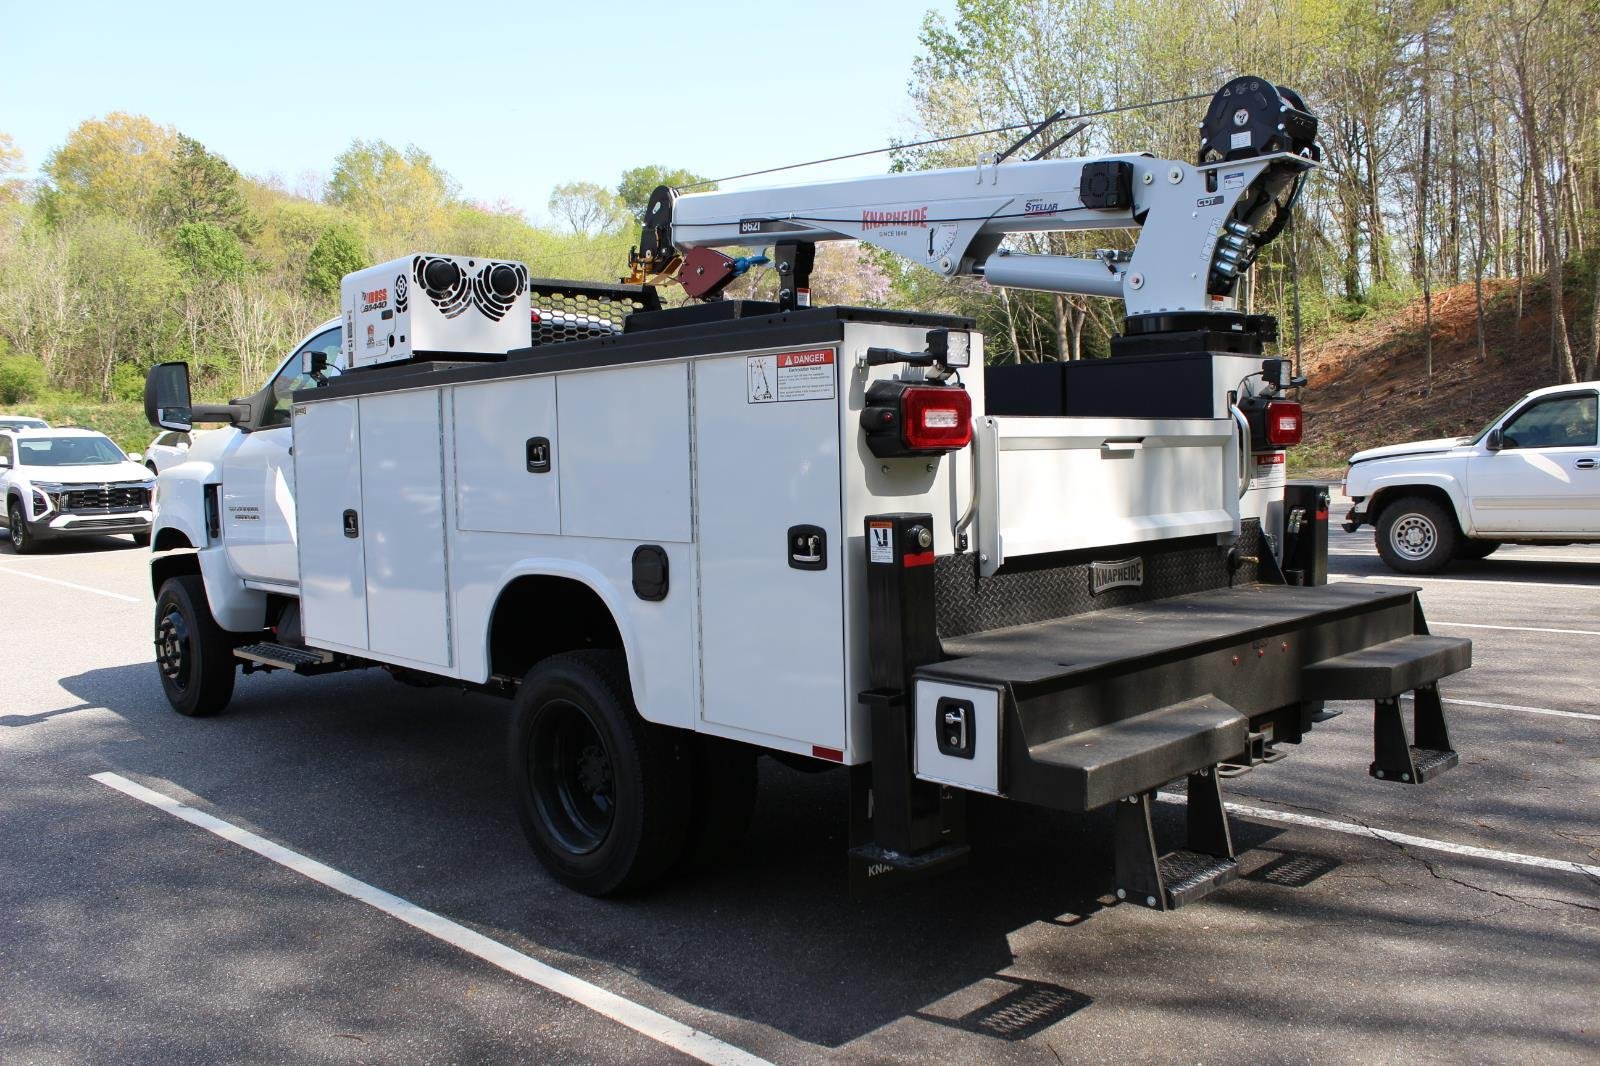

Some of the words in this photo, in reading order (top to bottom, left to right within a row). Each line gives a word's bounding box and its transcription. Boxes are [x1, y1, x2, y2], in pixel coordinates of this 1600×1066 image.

[1025, 202, 1058, 212] STELLAR
[862, 206, 928, 231] KNAPHEIDE
[793, 353, 825, 364] DANGER
[1096, 562, 1141, 588] KNAPHEIDE
